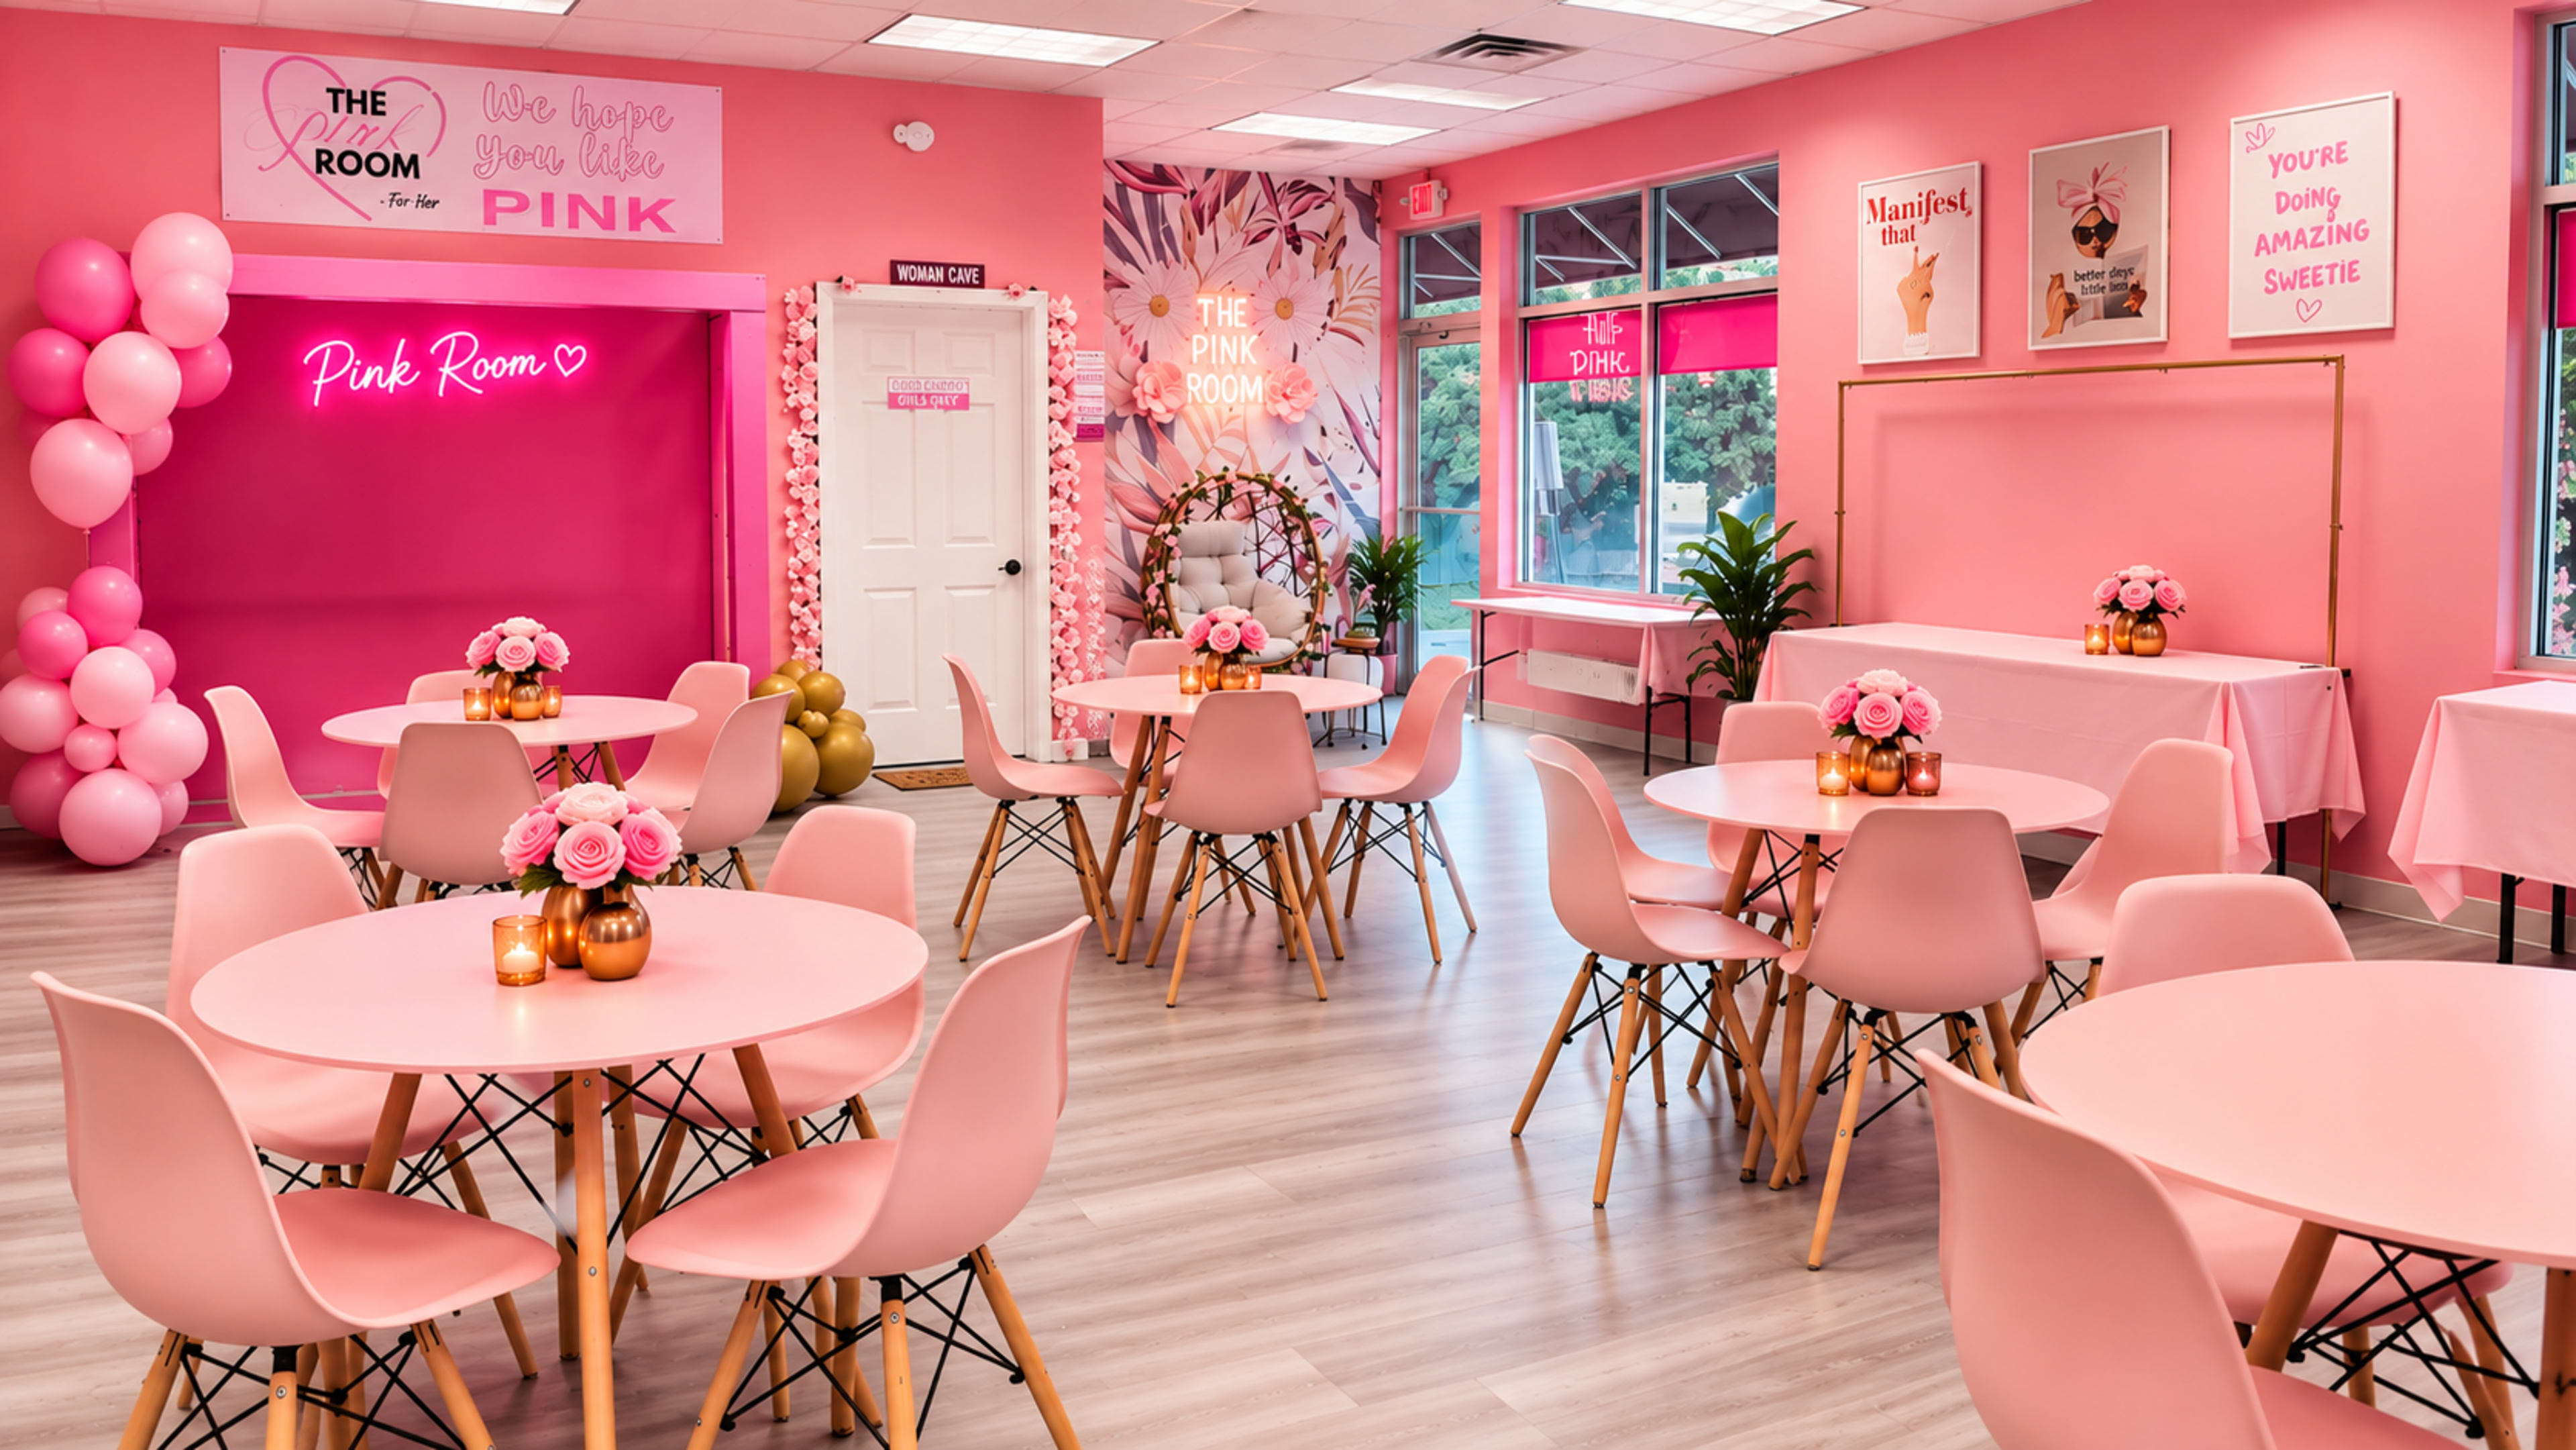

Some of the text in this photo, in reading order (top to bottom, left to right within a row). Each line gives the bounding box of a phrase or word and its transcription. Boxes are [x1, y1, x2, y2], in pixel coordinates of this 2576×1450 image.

[326, 87, 386, 116] THE
[483, 81, 674, 144] We hope
[315, 148, 420, 180] ROOM
[579, 132, 665, 182] like
[2268, 140, 2349, 179] YOU'RE
[388, 192, 410, 208] For
[415, 193, 440, 209] Her
[483, 189, 677, 234] PINK
[1882, 224, 1915, 246] that
[2254, 218, 2370, 257] AMAZING
[897, 264, 979, 284] WOMAN CAVE
[1197, 295, 1247, 327] THE
[1192, 334, 1258, 364] PINK
[303, 331, 547, 407] Pink Room
[1187, 372, 1263, 403] ROOM
